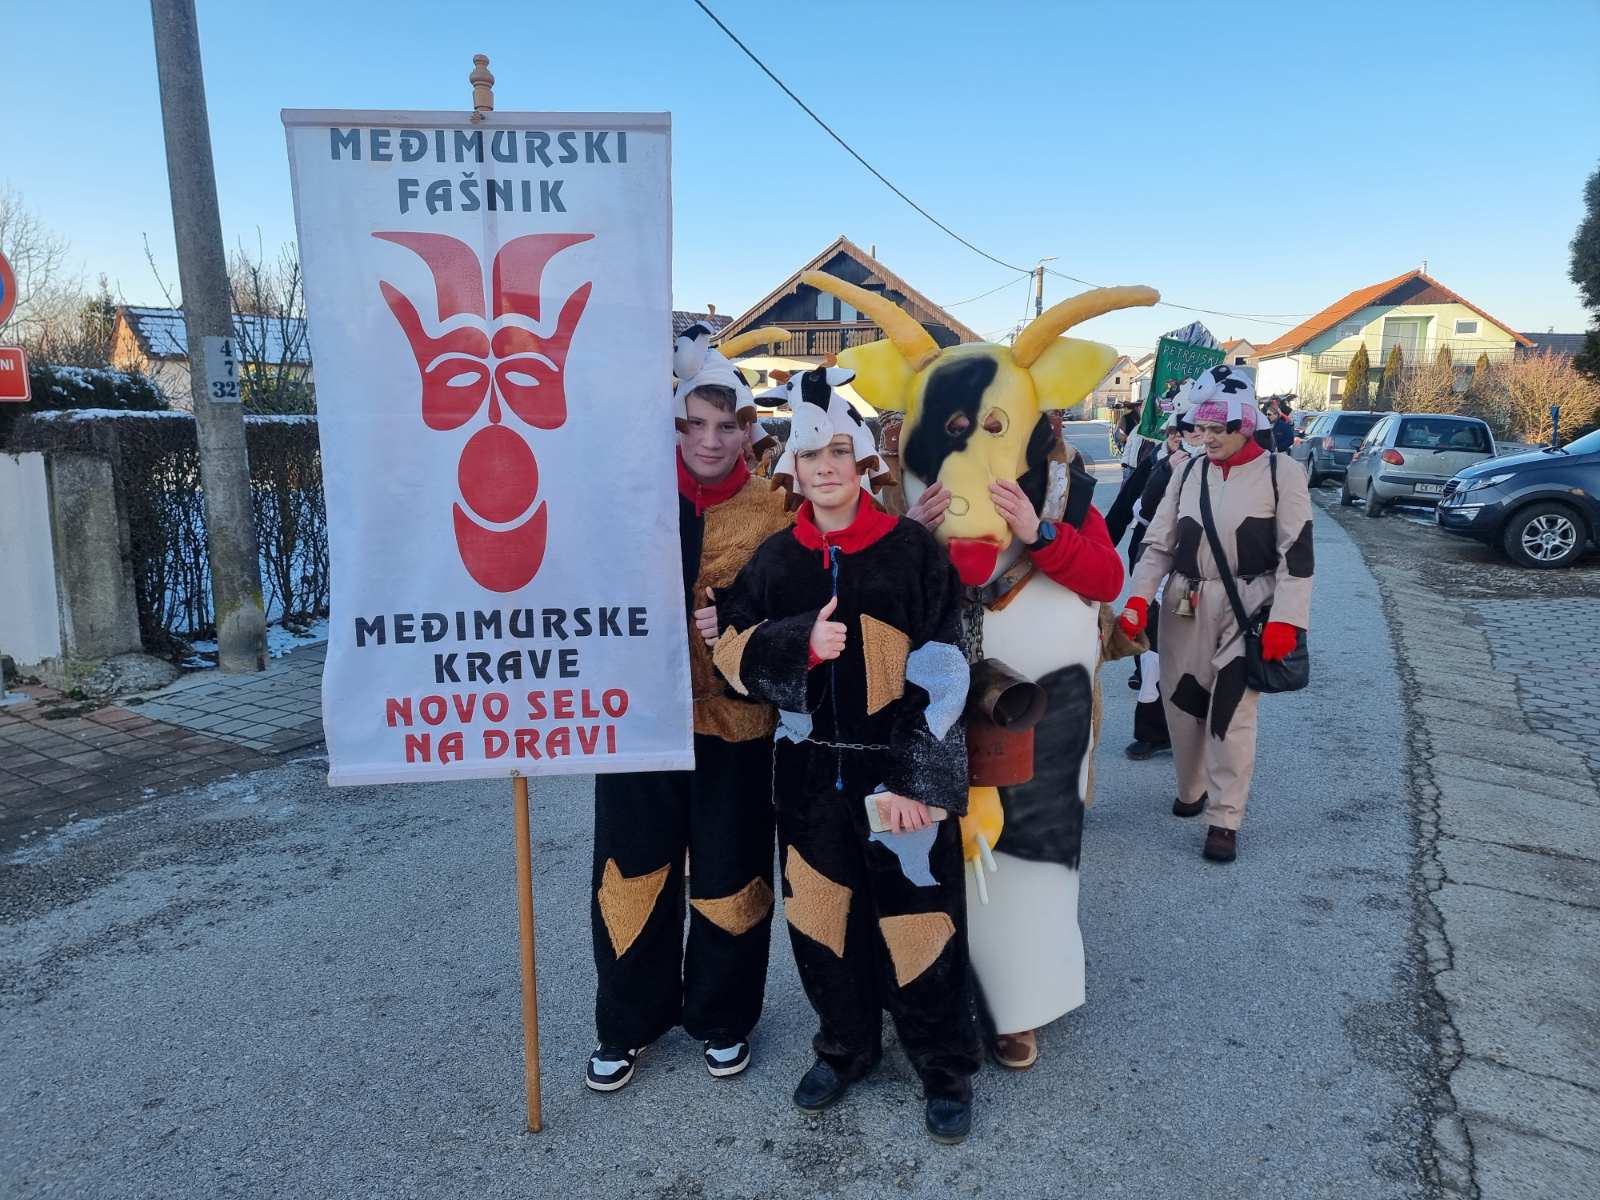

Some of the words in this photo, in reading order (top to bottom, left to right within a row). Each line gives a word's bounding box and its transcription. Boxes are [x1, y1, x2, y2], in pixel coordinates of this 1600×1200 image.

[330, 127, 628, 168] MEĐIMURSKI
[397, 171, 568, 215] FAŠNIK
[220, 340, 232, 357] 4
[225, 360, 234, 376] 7
[354, 606, 649, 648] MEĐIMURSKE
[434, 648, 580, 685] KRAVE
[386, 692, 510, 728] NOVO
[527, 688, 630, 721] SELO
[404, 731, 464, 766] NA
[482, 725, 617, 761] DRAVI
